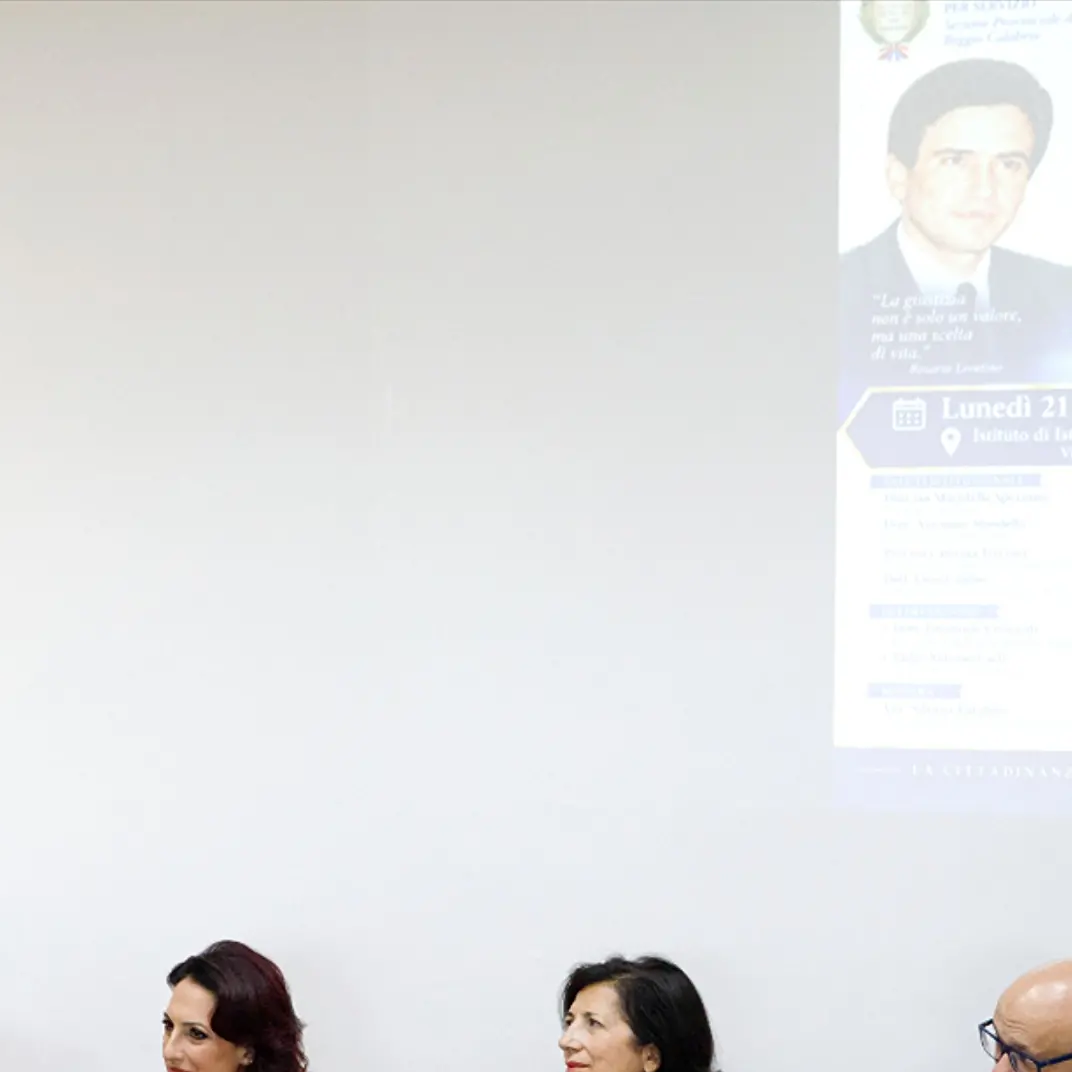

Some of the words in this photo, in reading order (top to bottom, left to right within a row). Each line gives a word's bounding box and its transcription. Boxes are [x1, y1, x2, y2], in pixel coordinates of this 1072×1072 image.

[871, 313, 899, 326] non
[932, 326, 974, 342] scelta
[871, 345, 886, 361] di
[942, 394, 1032, 420] Lunedì
[1040, 395, 1068, 419] 21
[1033, 427, 1051, 443] di
